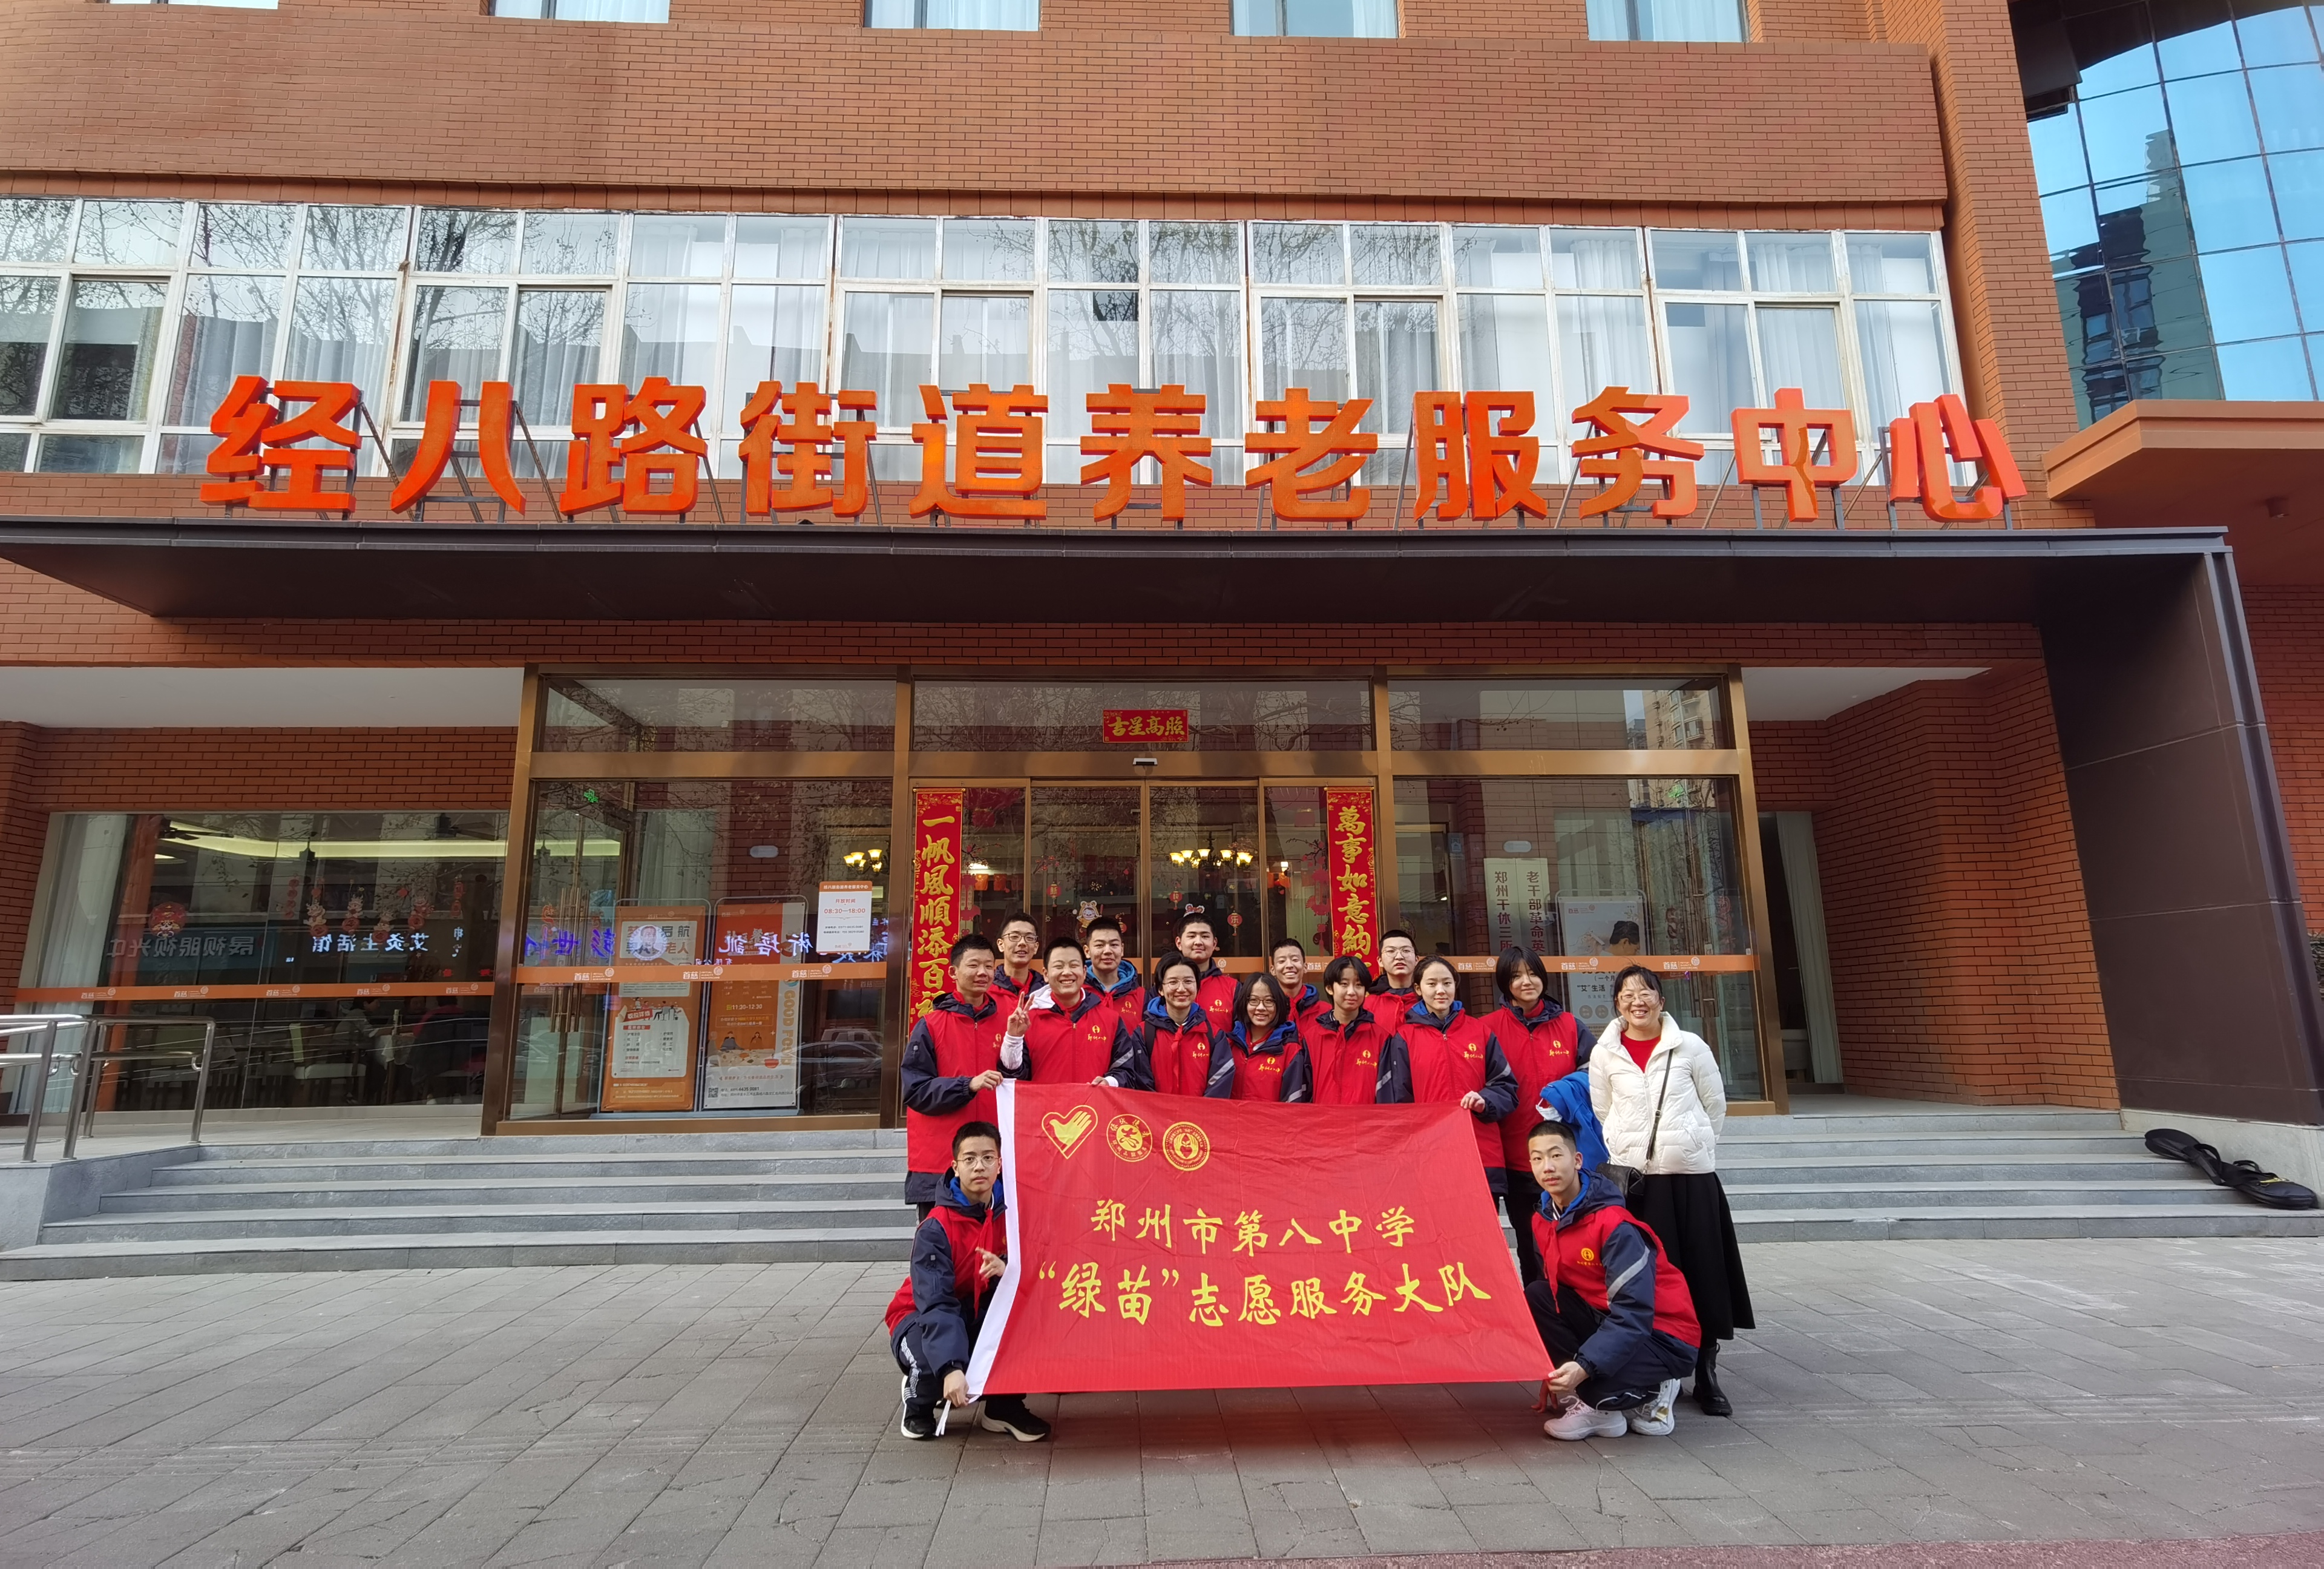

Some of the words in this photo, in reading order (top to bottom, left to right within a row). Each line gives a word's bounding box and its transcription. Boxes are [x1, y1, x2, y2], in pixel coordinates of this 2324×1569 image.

[200, 375, 2027, 522] 经八路街道养老服务中心
[1108, 715, 1185, 736] 吉星高照
[1335, 806, 1372, 967] 萬事如意納
[1495, 871, 1513, 952] 郑州干休三所
[1091, 1199, 1415, 1257] 郑州市第八中学
[1039, 1260, 1492, 1327] “绿苗”志愿服务大队
